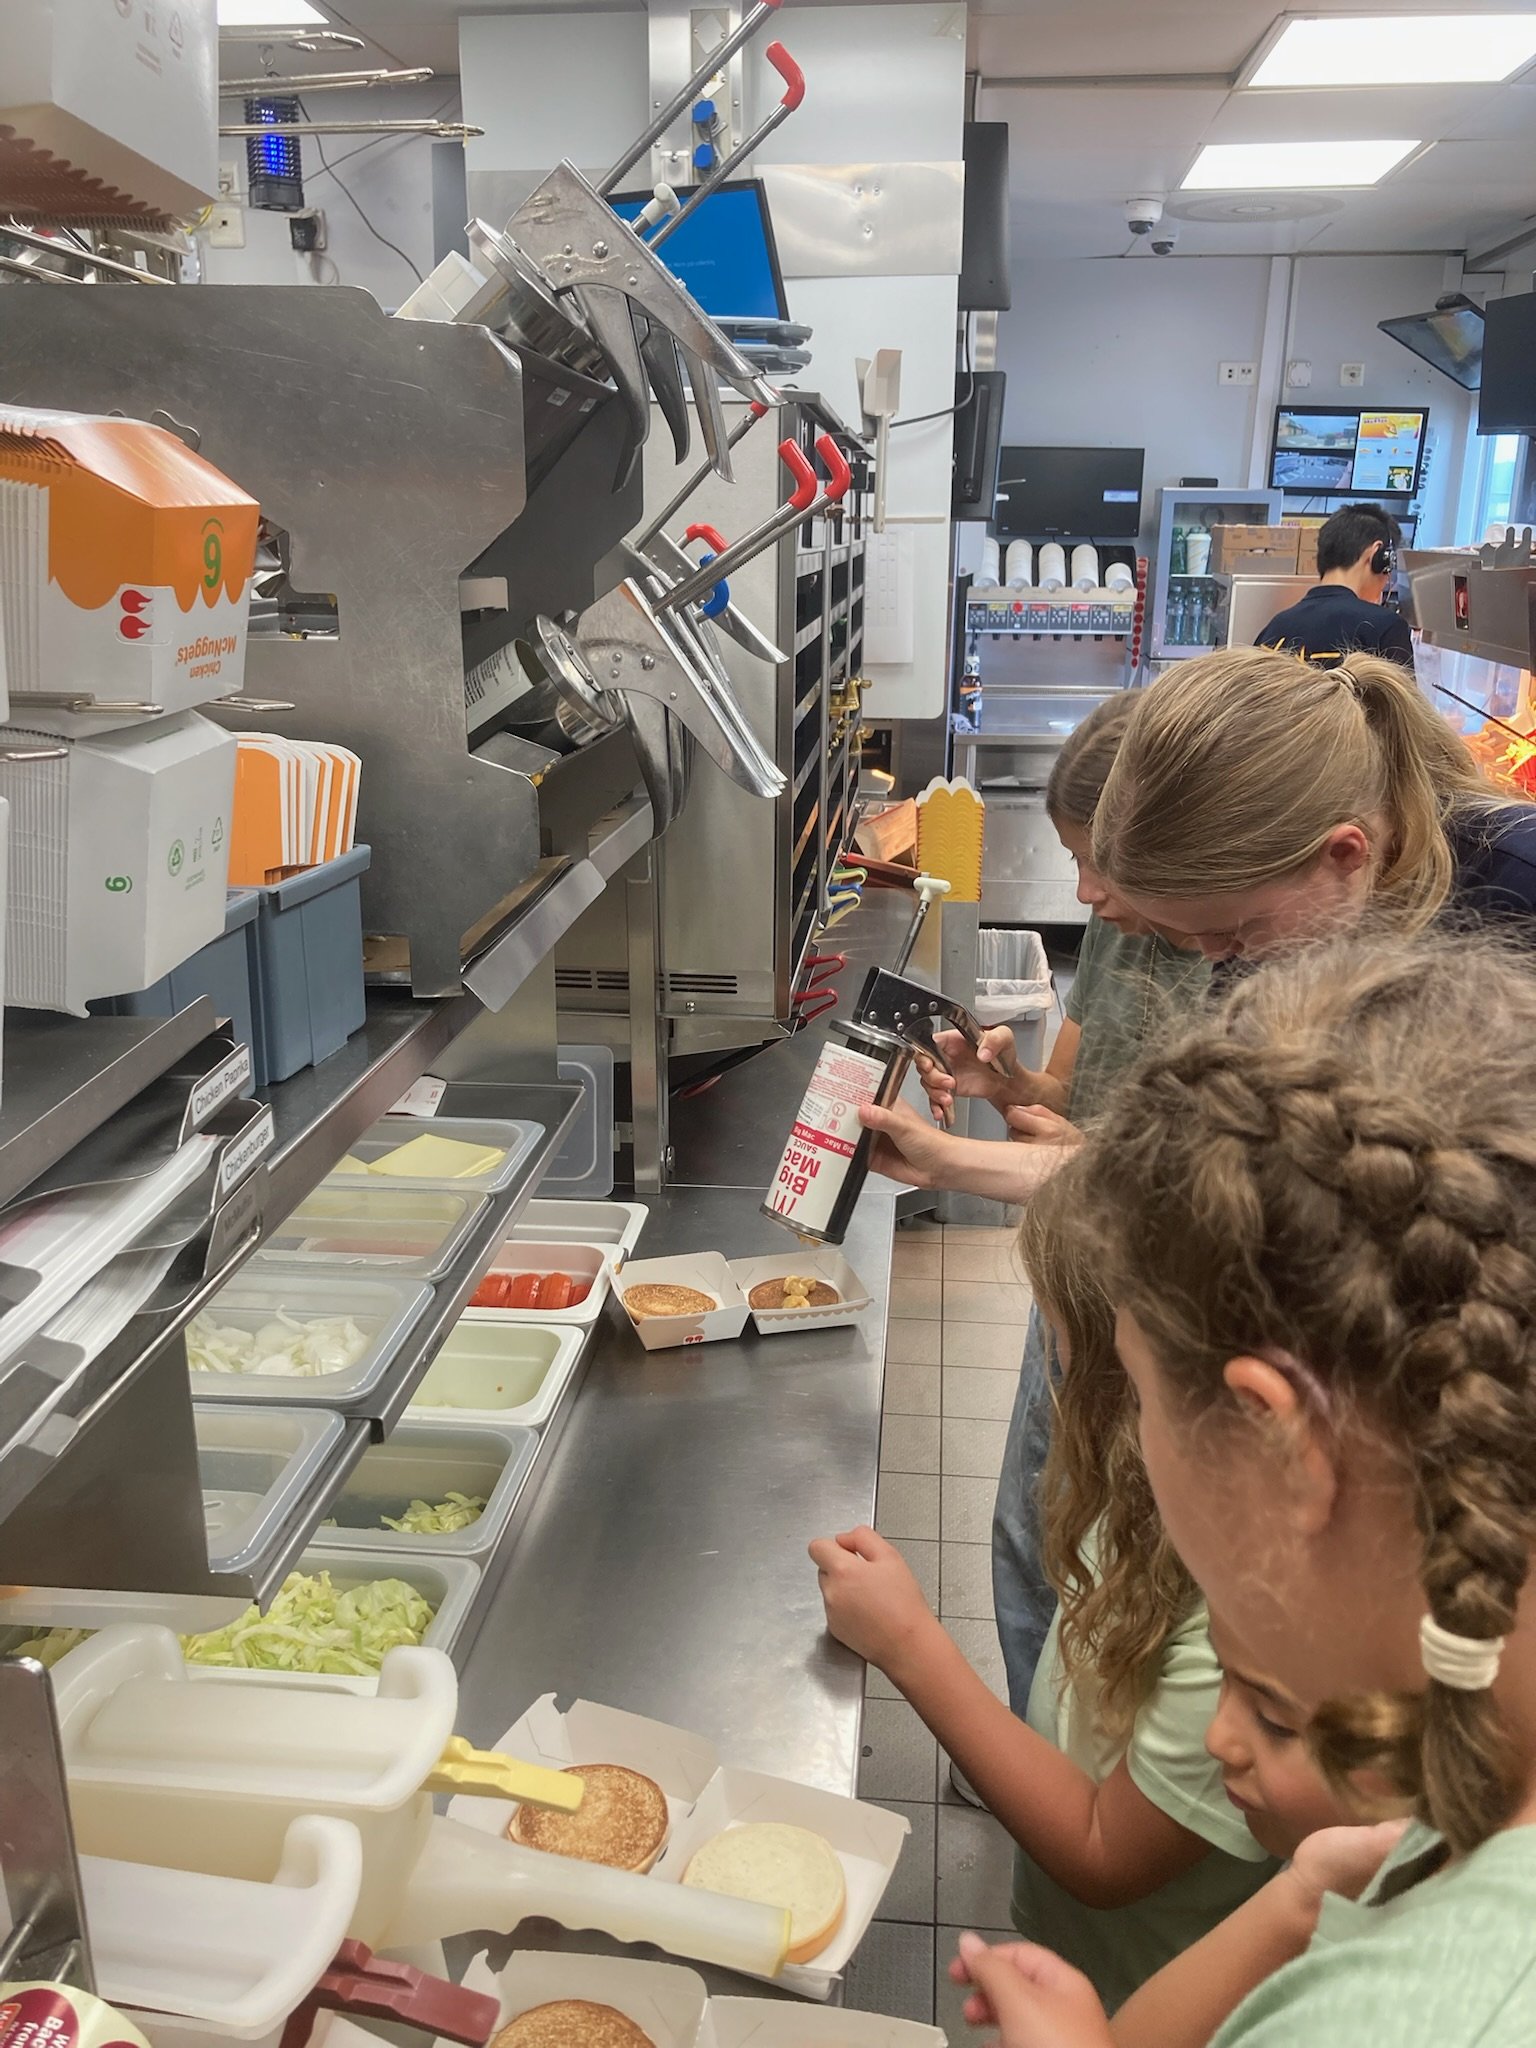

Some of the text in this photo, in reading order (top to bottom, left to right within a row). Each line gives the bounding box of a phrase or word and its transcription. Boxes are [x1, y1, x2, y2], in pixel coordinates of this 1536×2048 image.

[190, 660, 221, 679] Chicken
[195, 1059, 249, 1114] Chicken Paprika
[225, 1126, 270, 1180] Chickenburger
[793, 1138, 818, 1154] SAUCE
[824, 1137, 842, 1150] Mac
[784, 1148, 821, 1178] Mac
[779, 1165, 809, 1196] Big
